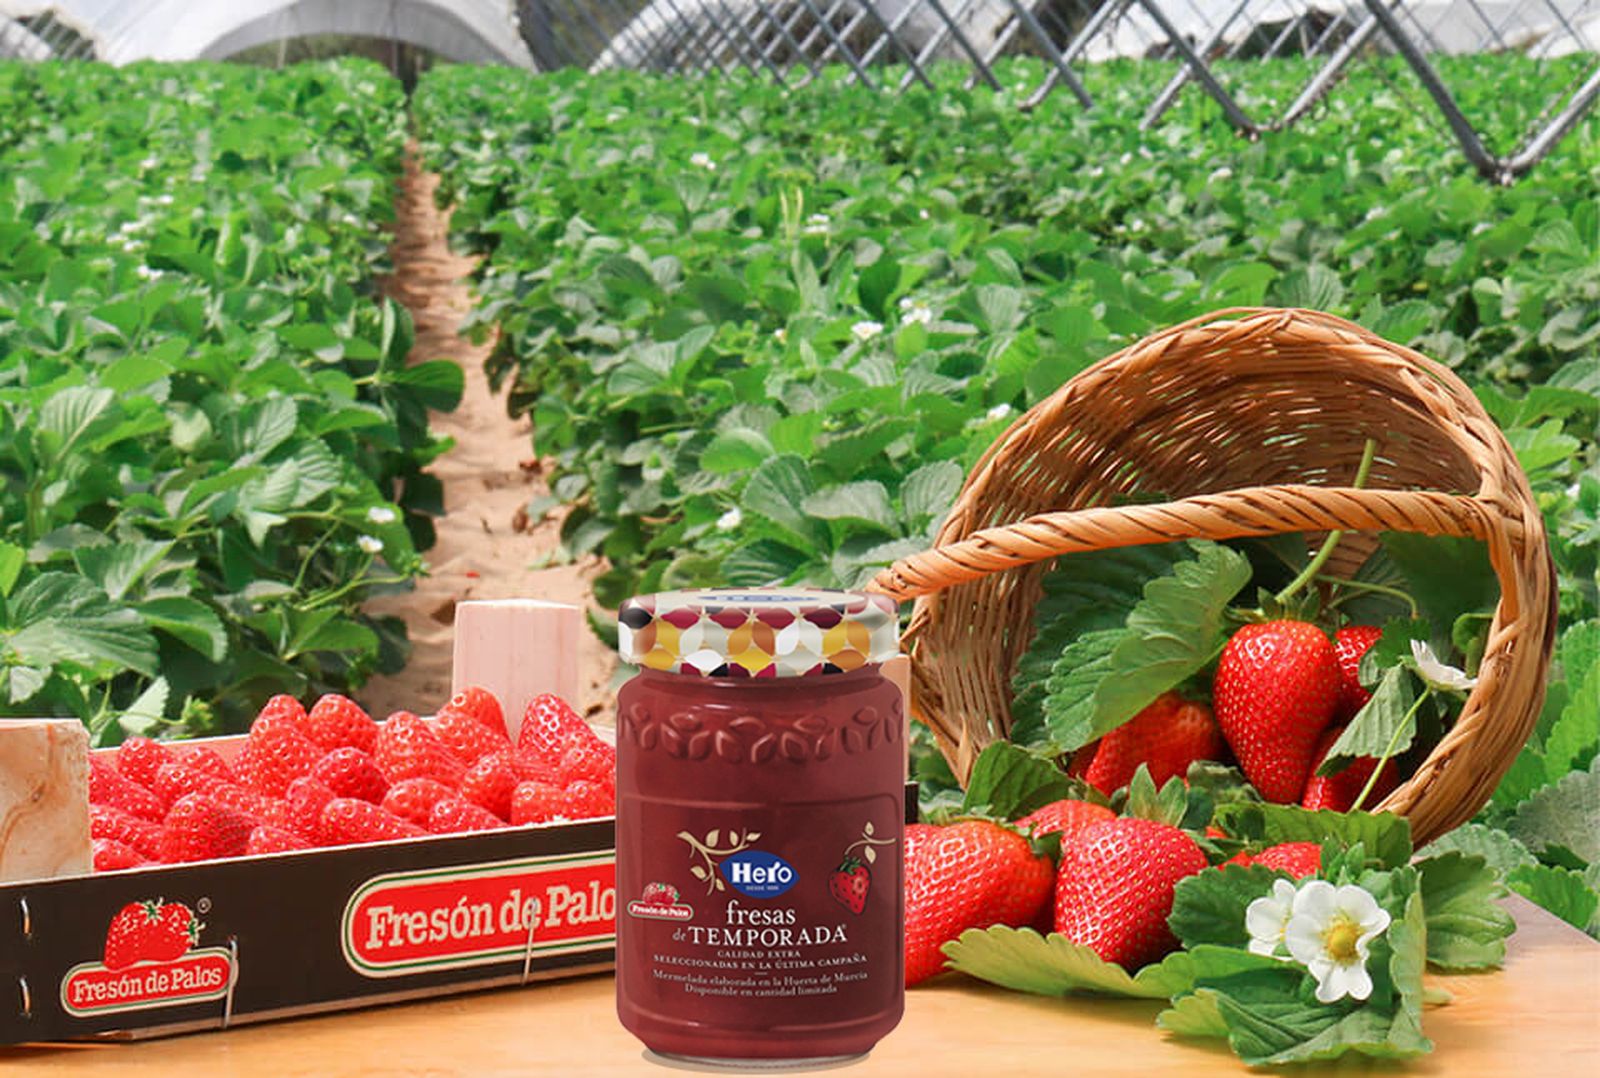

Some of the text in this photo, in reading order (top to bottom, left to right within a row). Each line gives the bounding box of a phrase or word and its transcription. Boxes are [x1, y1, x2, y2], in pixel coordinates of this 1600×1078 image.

[732, 862, 792, 883] Hero
[365, 895, 494, 950] Fresón
[499, 889, 542, 932] de
[727, 900, 795, 925] fresas
[672, 926, 847, 947] de TEMPORADA
[653, 954, 738, 969] SELECCIONADAS
[775, 959, 815, 969] ÚLTIMA
[818, 953, 867, 967] CAMPAÑA
[767, 950, 801, 958] EXTRA
[73, 965, 223, 1003] Fresón de Palos
[653, 969, 708, 984] Mermelada
[710, 975, 756, 986] elaborada
[773, 977, 781, 986] la
[784, 976, 818, 986] Huerta
[820, 974, 831, 983] de
[834, 971, 868, 982] Murcia
[684, 983, 738, 996] Disponible
[755, 986, 796, 996] cantidad
[798, 983, 837, 995] limitada
